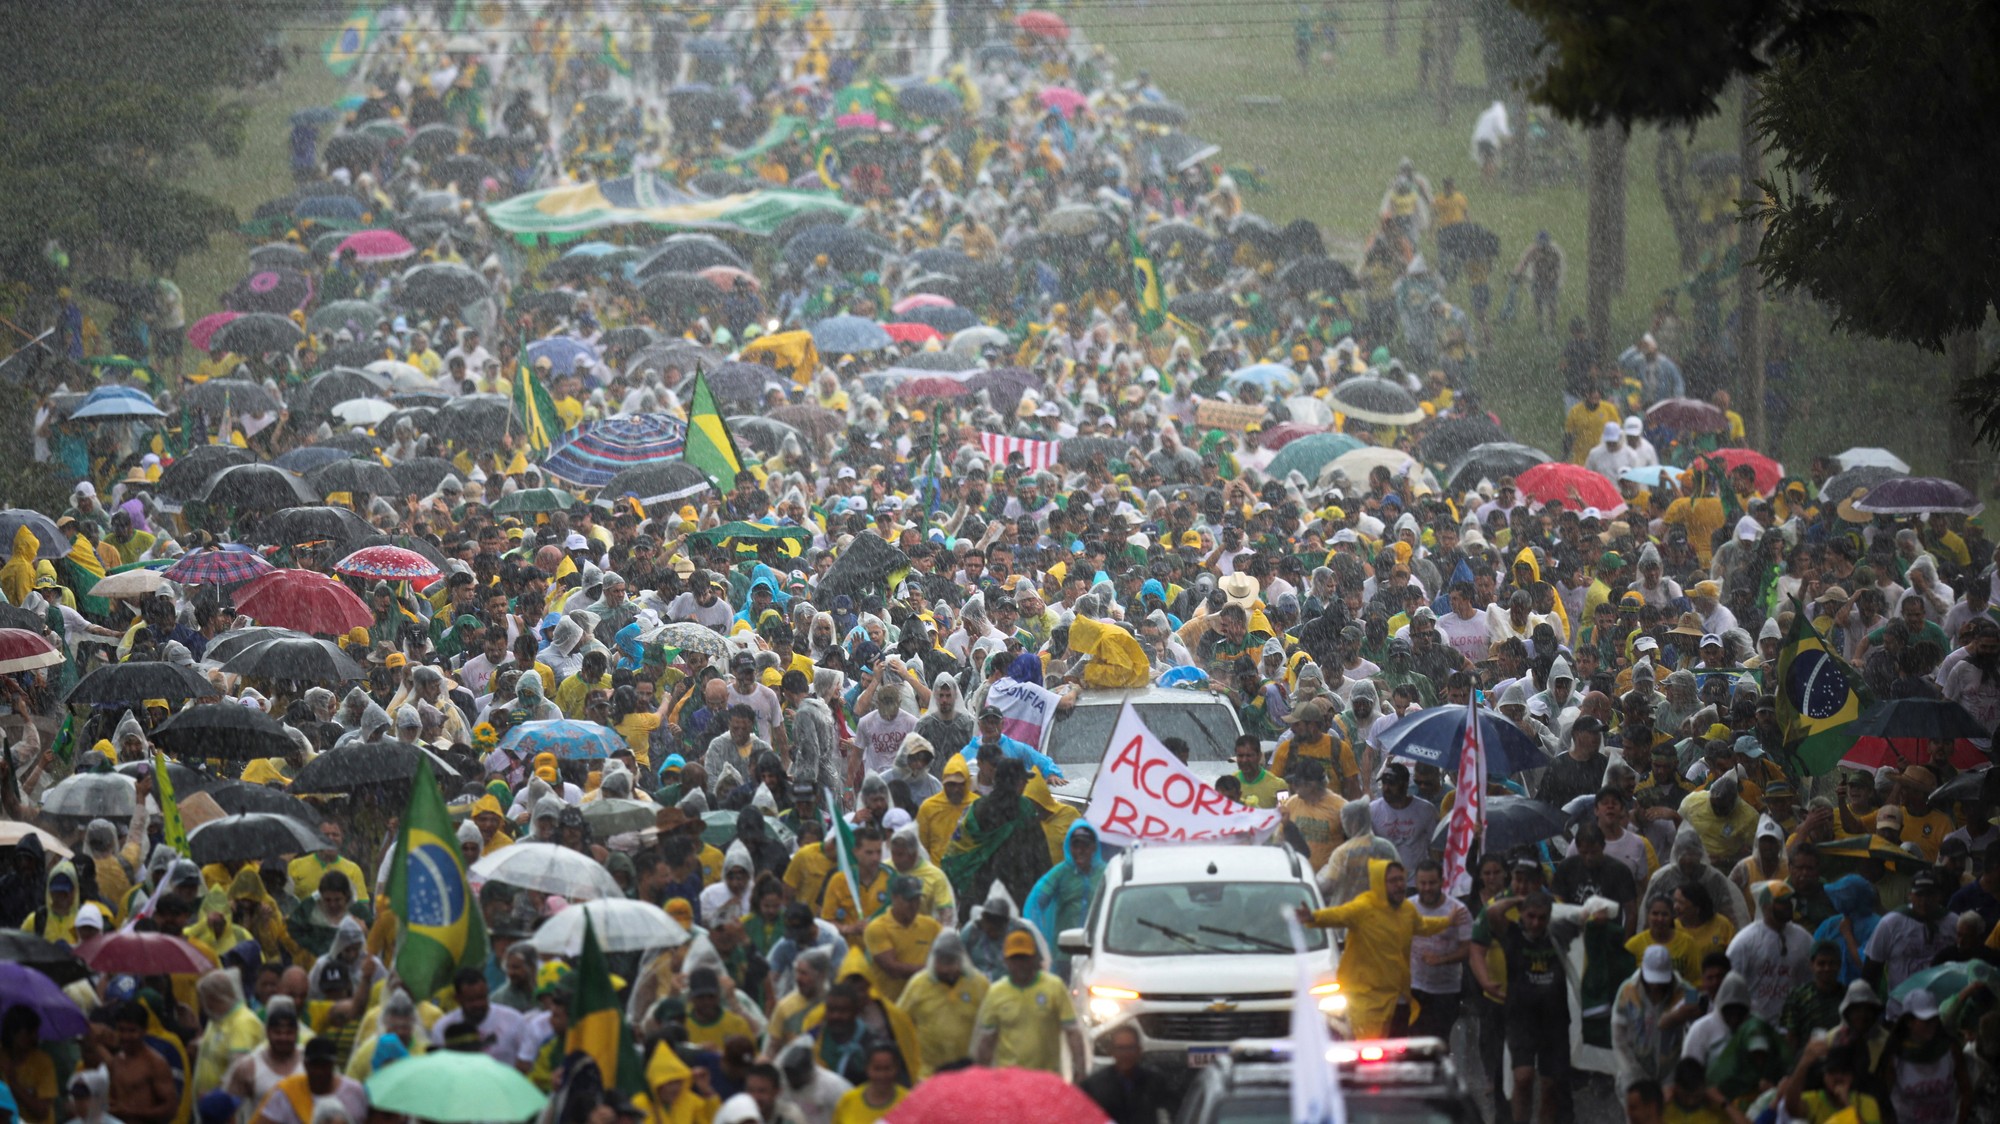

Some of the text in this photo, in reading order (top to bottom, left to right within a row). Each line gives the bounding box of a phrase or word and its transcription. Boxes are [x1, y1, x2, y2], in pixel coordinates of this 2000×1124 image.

[874, 742, 901, 754] BRASI
[1111, 734, 1256, 816] ACOR
[1101, 796, 1256, 841] BRAS
